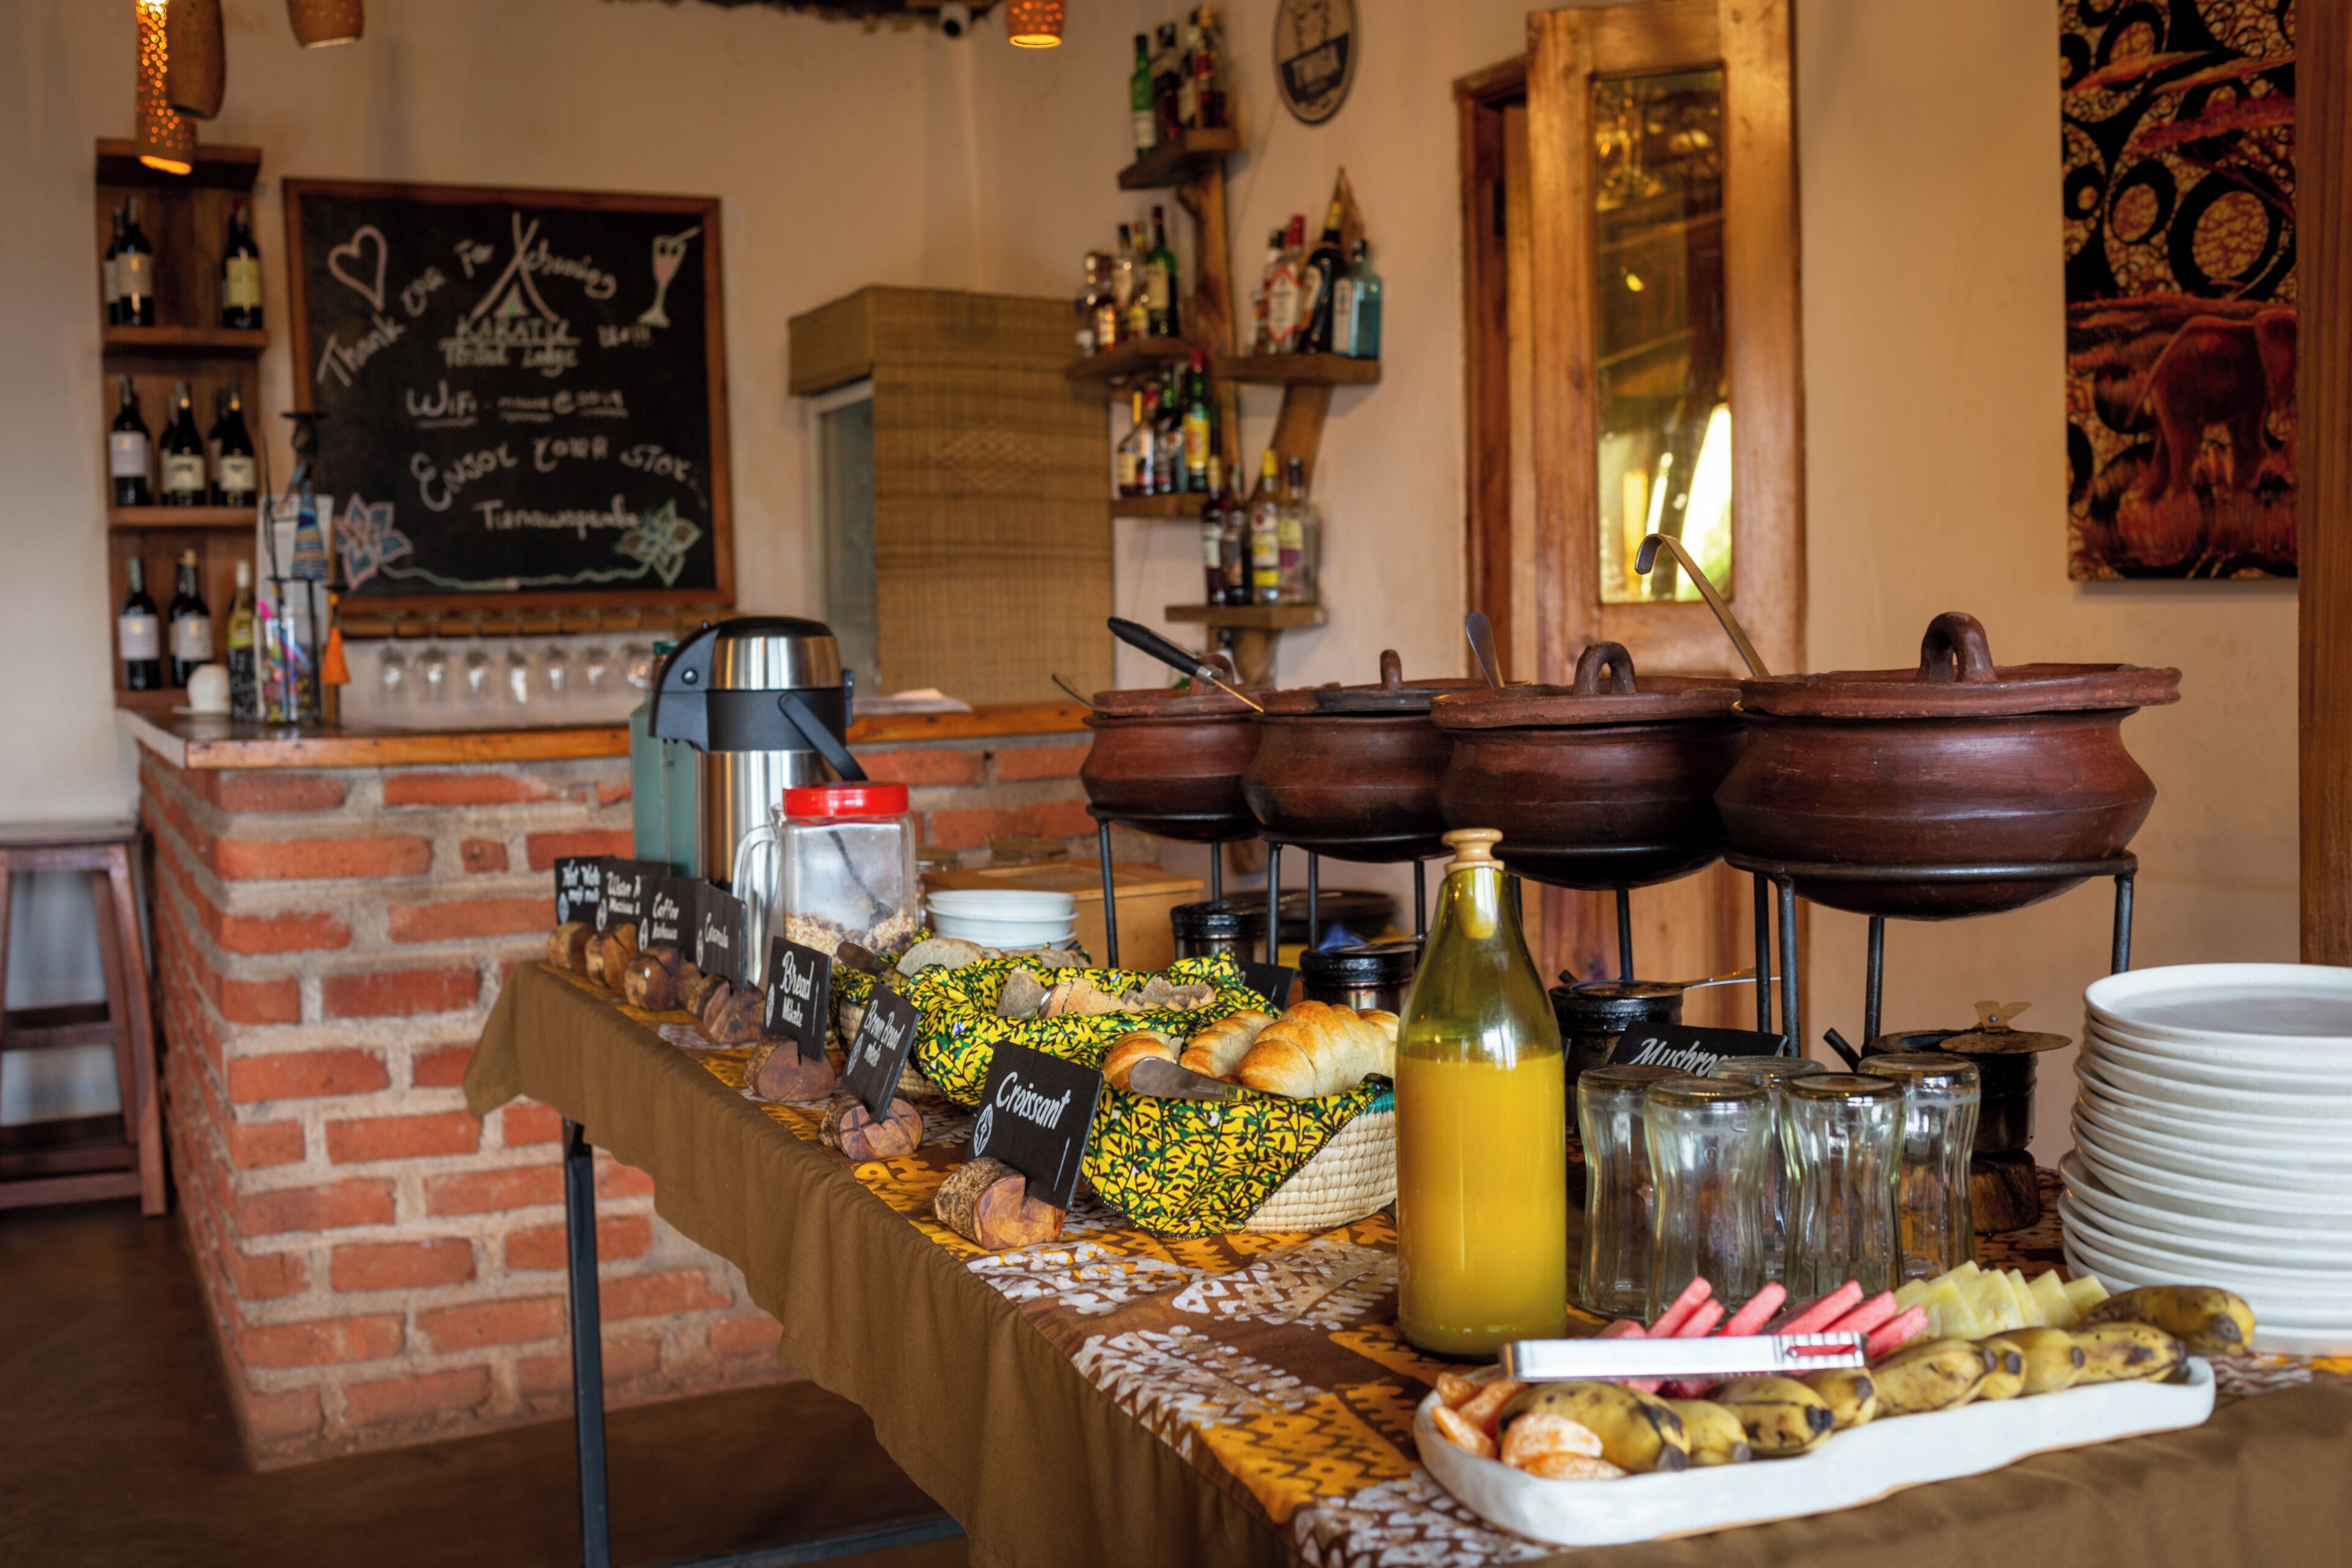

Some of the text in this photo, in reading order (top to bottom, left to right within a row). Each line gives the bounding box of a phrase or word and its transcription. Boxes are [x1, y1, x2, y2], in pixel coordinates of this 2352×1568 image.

[316, 312, 405, 388] Thank
[780, 951, 815, 1001] Bread
[880, 1011, 906, 1052] Bread
[996, 1071, 1071, 1130] Croissant
